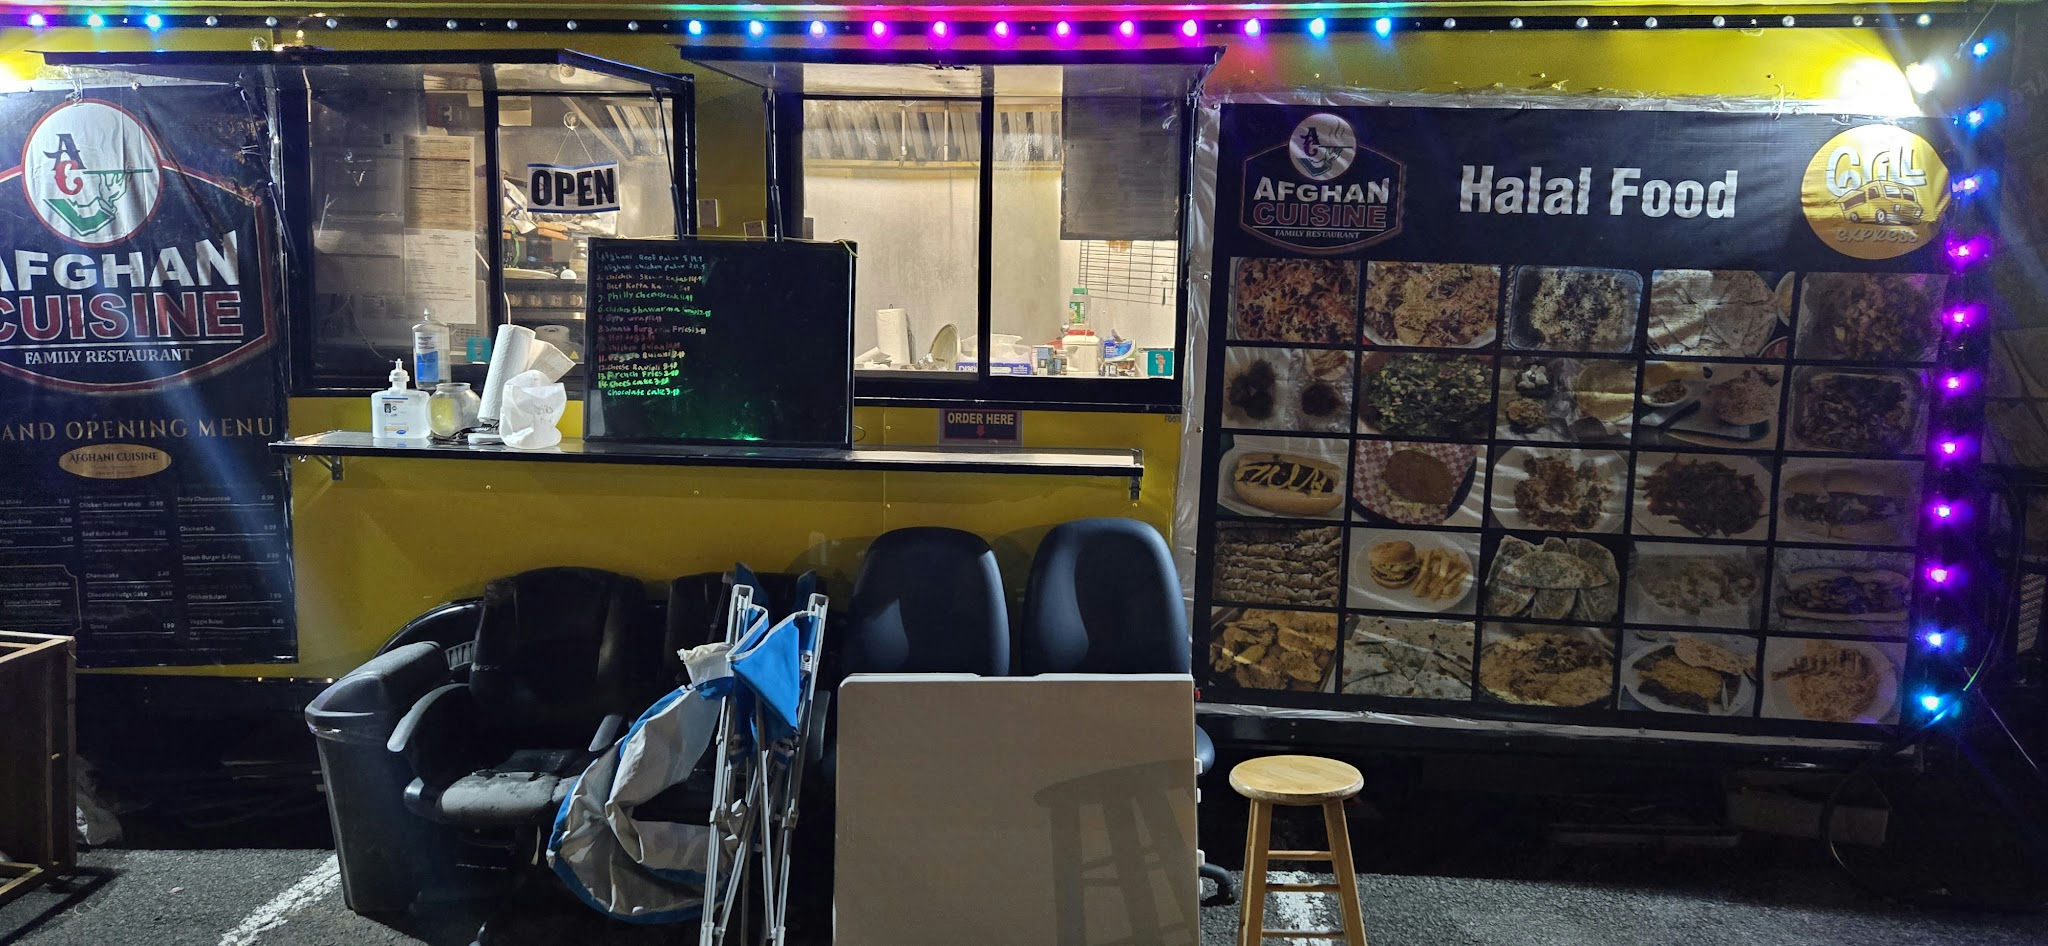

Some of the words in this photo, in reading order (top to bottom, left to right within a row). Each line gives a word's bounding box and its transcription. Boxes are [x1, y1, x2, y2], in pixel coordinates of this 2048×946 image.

[531, 168, 615, 207] OPEN
[1253, 176, 1390, 204] AFGHAN
[1460, 165, 1592, 215] Halal
[1610, 168, 1738, 218] Food
[1253, 202, 1388, 229] CUISINE
[1275, 229, 1304, 238] FAMILY
[1306, 230, 1361, 239] RESTAURANT
[608, 290, 634, 302] Philly
[25, 351, 80, 365] FAMILY
[86, 349, 194, 363] RESTAURANT
[947, 412, 983, 425] ORDER
[986, 412, 1014, 425] HERE
[65, 418, 189, 440] OPENING
[199, 417, 274, 437] MENU
[70, 452, 114, 464] AFGHANI
[116, 451, 158, 463] CUISINE
